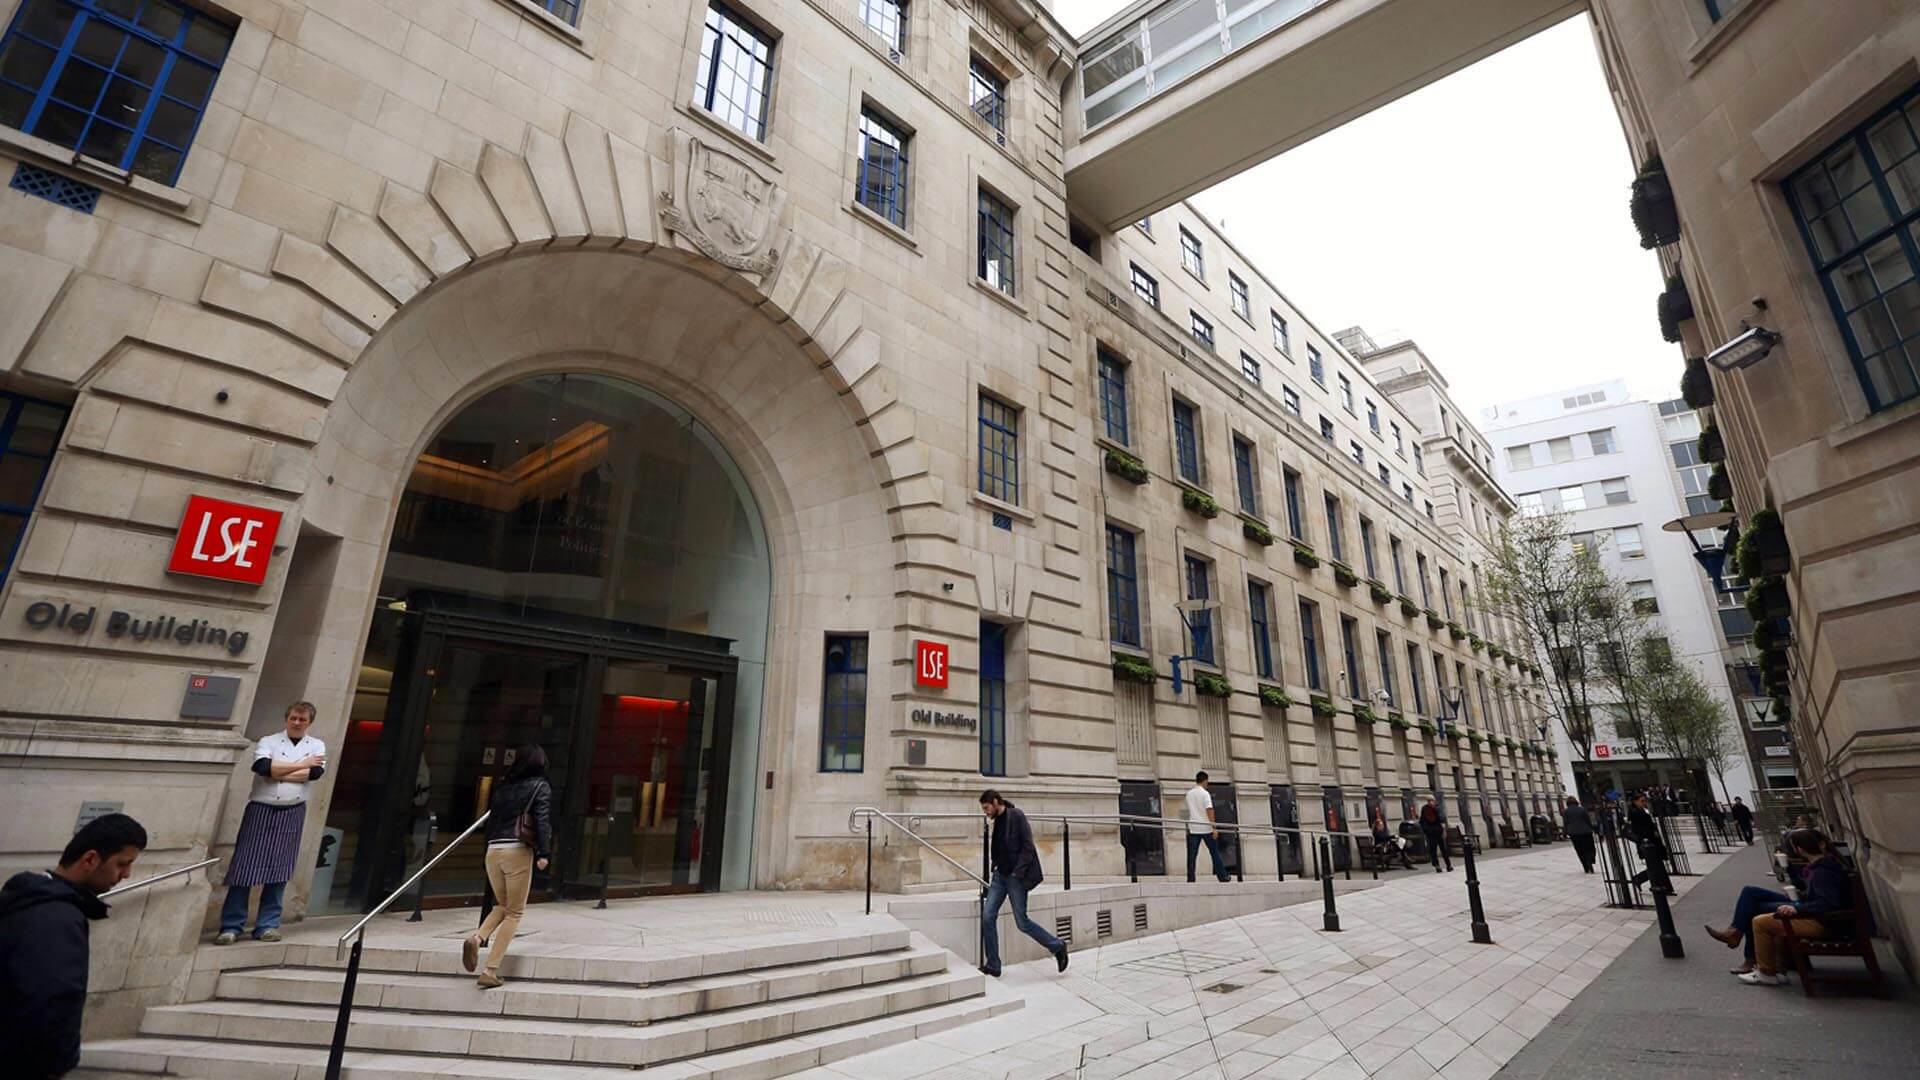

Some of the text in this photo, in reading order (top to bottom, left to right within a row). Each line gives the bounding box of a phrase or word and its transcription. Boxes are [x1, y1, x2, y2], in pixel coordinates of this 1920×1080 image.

[191, 511, 264, 569] LSE
[25, 602, 249, 655] Old Building
[923, 649, 943, 680] LSE
[912, 710, 977, 732] Old Building
[1611, 746, 1622, 755] St
